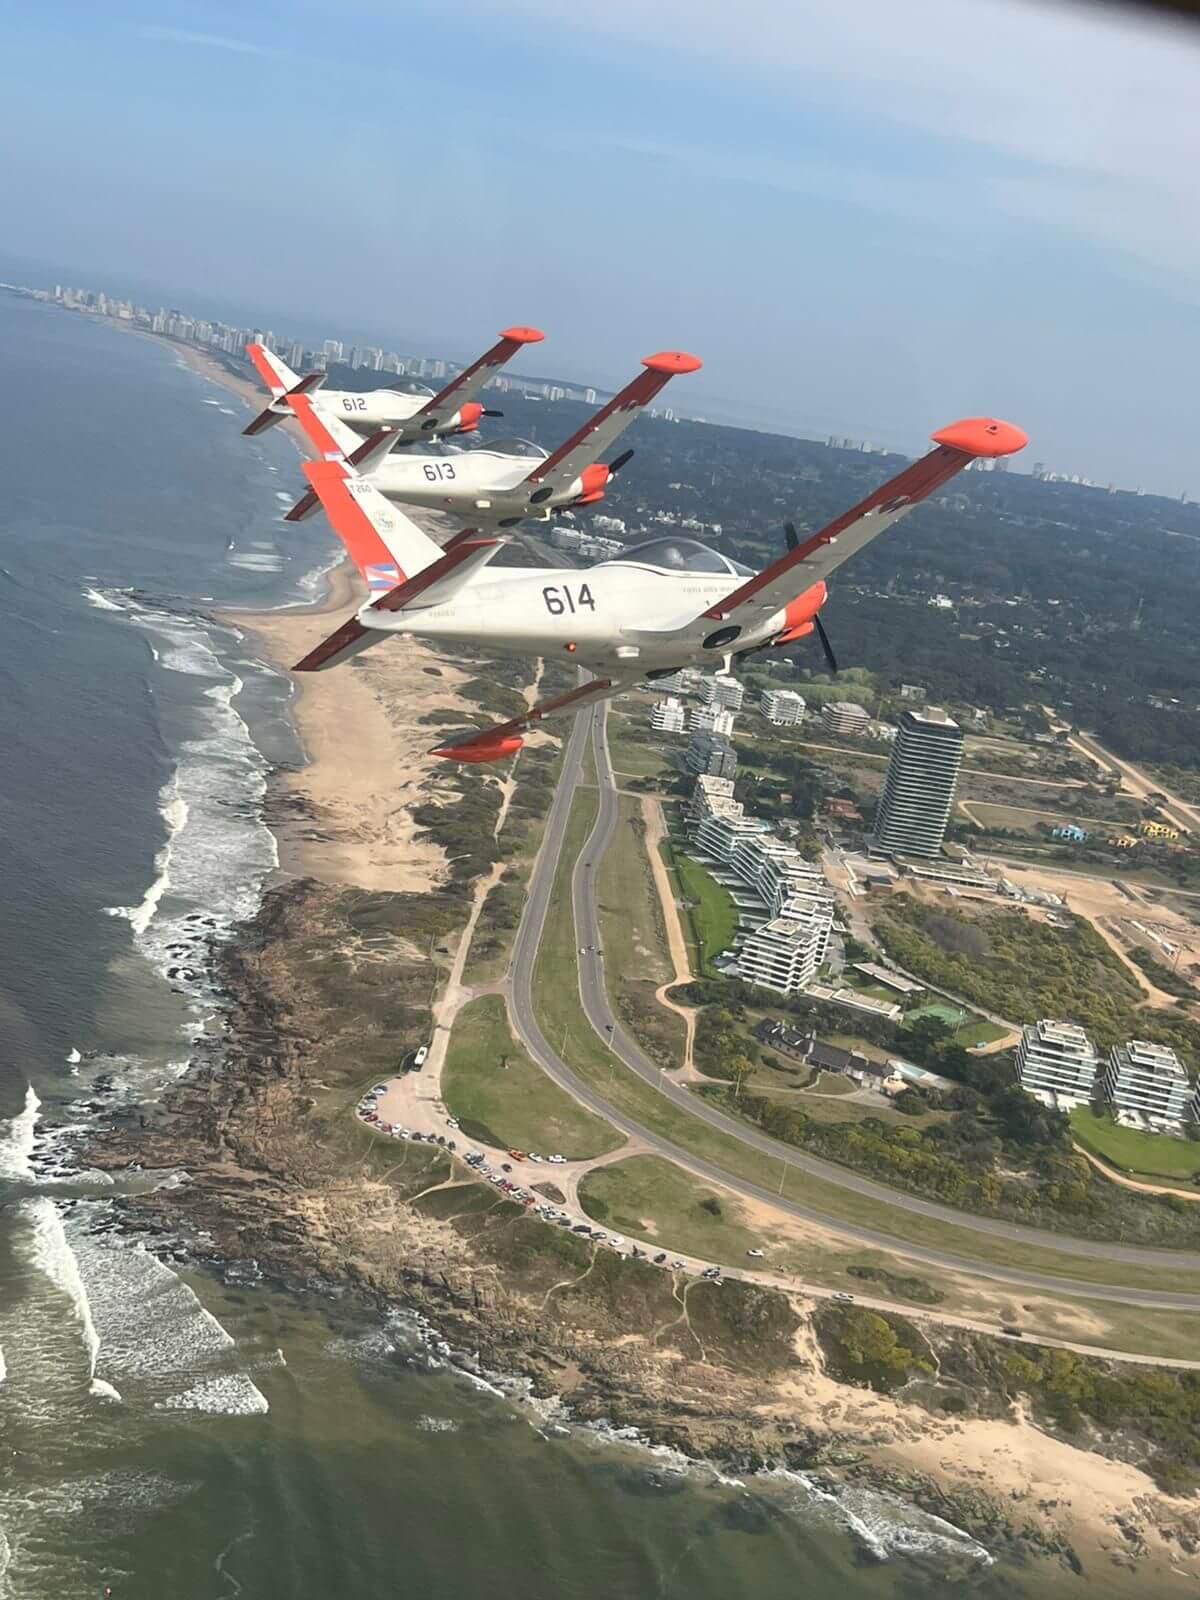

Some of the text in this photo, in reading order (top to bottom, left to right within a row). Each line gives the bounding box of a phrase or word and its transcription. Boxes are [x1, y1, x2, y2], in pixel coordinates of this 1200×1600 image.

[343, 398, 368, 411] 612
[423, 463, 456, 481] 613
[542, 583, 596, 615] 614
